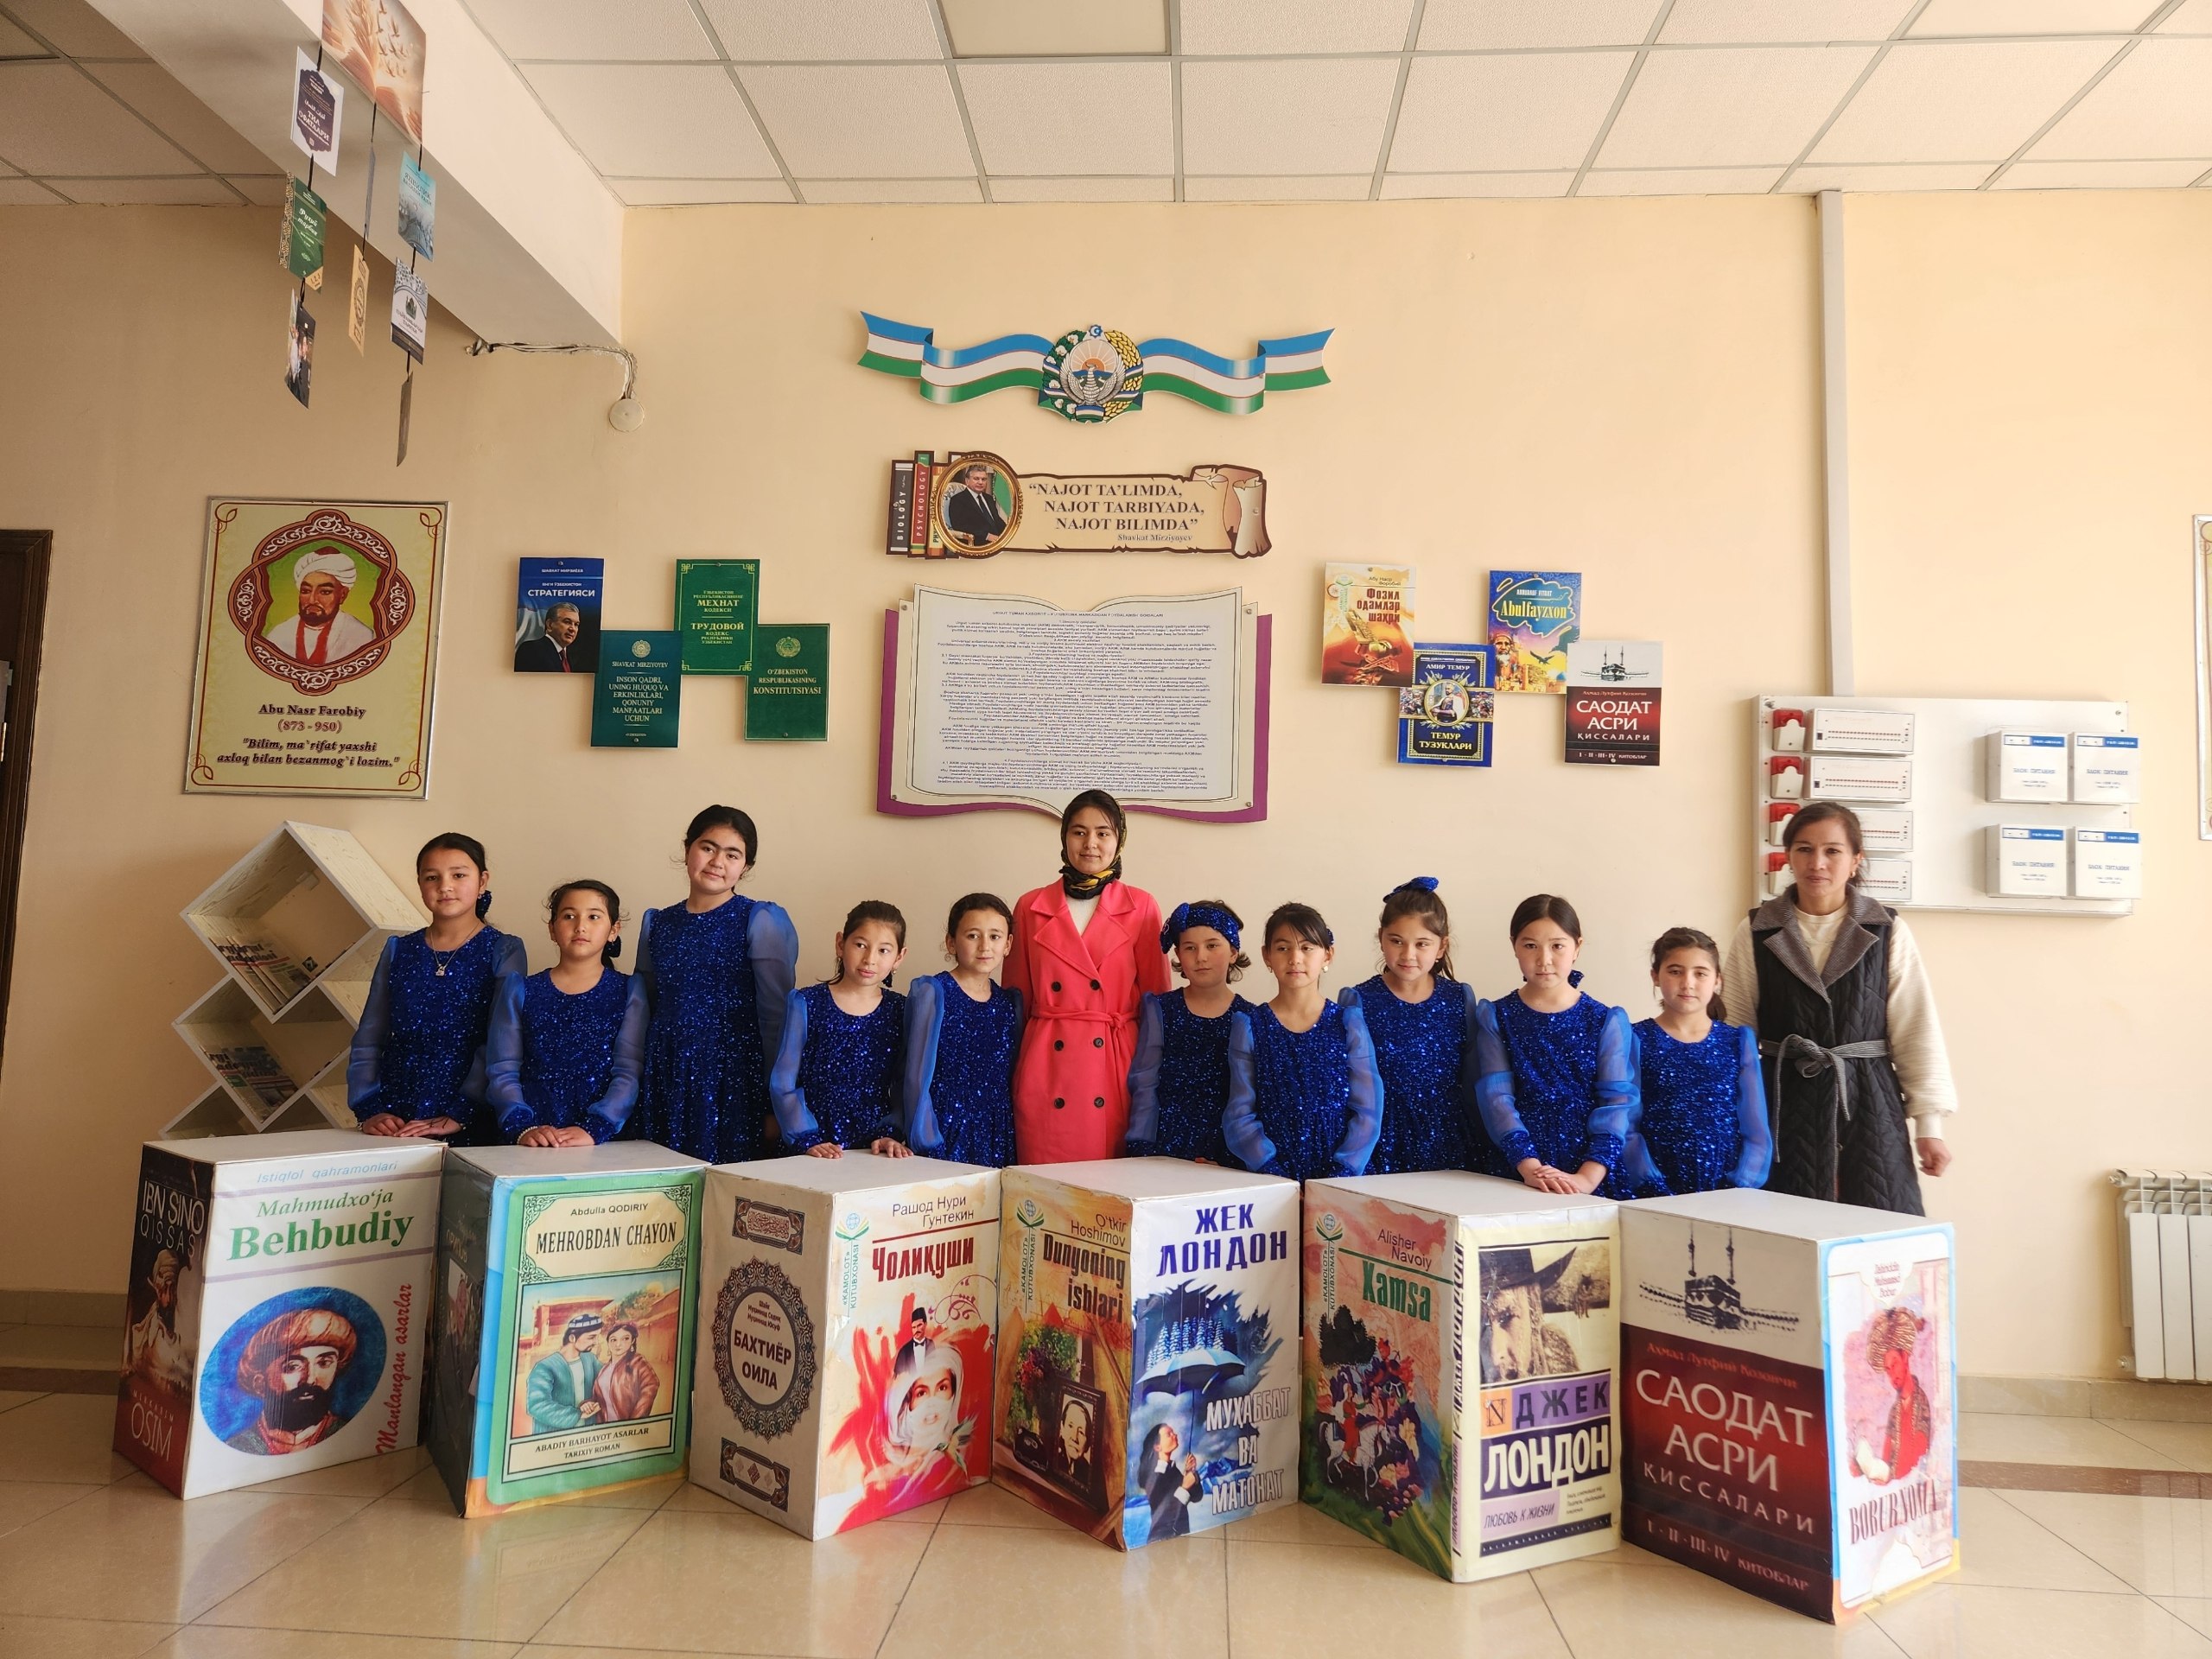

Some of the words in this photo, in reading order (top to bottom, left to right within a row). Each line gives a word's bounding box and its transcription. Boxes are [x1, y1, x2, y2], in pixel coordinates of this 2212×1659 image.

[916, 471, 926, 537] PSYCHOLOGY
[1029, 484, 1092, 496] “NAJOT
[1096, 484, 1182, 498] TA’LIMDA,
[897, 491, 906, 541] BIOLOGY
[1045, 501, 1099, 513] NAJOT
[1103, 501, 1205, 515] TARBIYADA,
[1056, 518, 1111, 531] NAJOT
[1115, 518, 1198, 531] BILIMDA”
[1151, 534, 1192, 543] Mirziyoyev
[1357, 600, 1401, 613] одамлар
[1367, 588, 1400, 601] Фозил
[1500, 600, 1567, 622] Abulfayzxon
[691, 622, 745, 631] ТРУДОВОЙ
[753, 686, 821, 695] KONSTITUTSIYASI
[258, 704, 283, 715] Abu
[287, 705, 316, 716] Nasr
[319, 705, 366, 719] Farobiy
[1576, 700, 1652, 715] САОДАТ
[1431, 732, 1460, 741] ТЕМУР
[1587, 717, 1637, 730] АСРИ
[339, 741, 377, 753] yaxshi
[1419, 741, 1472, 750] ТУЗУКЛАРИ
[218, 753, 250, 767] axloq
[252, 753, 283, 764] bilan
[257, 1170, 304, 1184] Istiqlol
[312, 1161, 398, 1179] qahramonlari
[143, 1180, 166, 1219] IBN
[168, 1191, 204, 1235] SINO
[570, 1206, 605, 1217] Abdulla
[608, 1203, 648, 1215] QODIRIY
[893, 1199, 933, 1217] Рашод
[937, 1195, 967, 1215] Нури
[923, 1209, 975, 1229] Гунтекин
[1194, 1203, 1255, 1236] ЖЕК
[141, 1213, 202, 1261] QISSASI
[226, 1210, 415, 1262] Behbudiy
[535, 1225, 621, 1255] MEHROBDAN
[626, 1222, 677, 1246] CHAYON
[1071, 1220, 1125, 1247] Hoshimov
[1377, 1229, 1417, 1251] Alisher
[1044, 1234, 1125, 1289] Dunyoning
[1156, 1230, 1287, 1277] ЛОНДОН
[1391, 1246, 1433, 1272] Navoiy
[850, 1244, 859, 1308] KUTUBXONASI
[394, 1284, 412, 1344] asarlar
[1068, 1278, 1123, 1324] ishlari
[734, 1329, 791, 1365] БАХТИЁР
[741, 1362, 778, 1390] ОИЛА
[1516, 1381, 1608, 1428] ДЖЕК
[1637, 1369, 1813, 1446] САОДАТ
[131, 1402, 173, 1462] OSIM
[536, 1440, 567, 1453] ABADIY
[569, 1433, 612, 1446] BARHAYOT
[613, 1427, 650, 1440] ASARLAR
[564, 1448, 593, 1459] TARIXIY
[594, 1443, 620, 1453] ROMAN
[1238, 1434, 1259, 1465] ВА
[1484, 1428, 1609, 1493] ЛОНДОН
[1664, 1425, 1778, 1492] АСРИ
[1211, 1469, 1284, 1516] МАТОНАТ
[1644, 1462, 1814, 1535] ҚИССАЛАРИ
[1484, 1510, 1517, 1529] ЛЮБОВЬ
[1520, 1510, 1526, 1521] К
[1527, 1503, 1555, 1520] ЖИЗНИ
